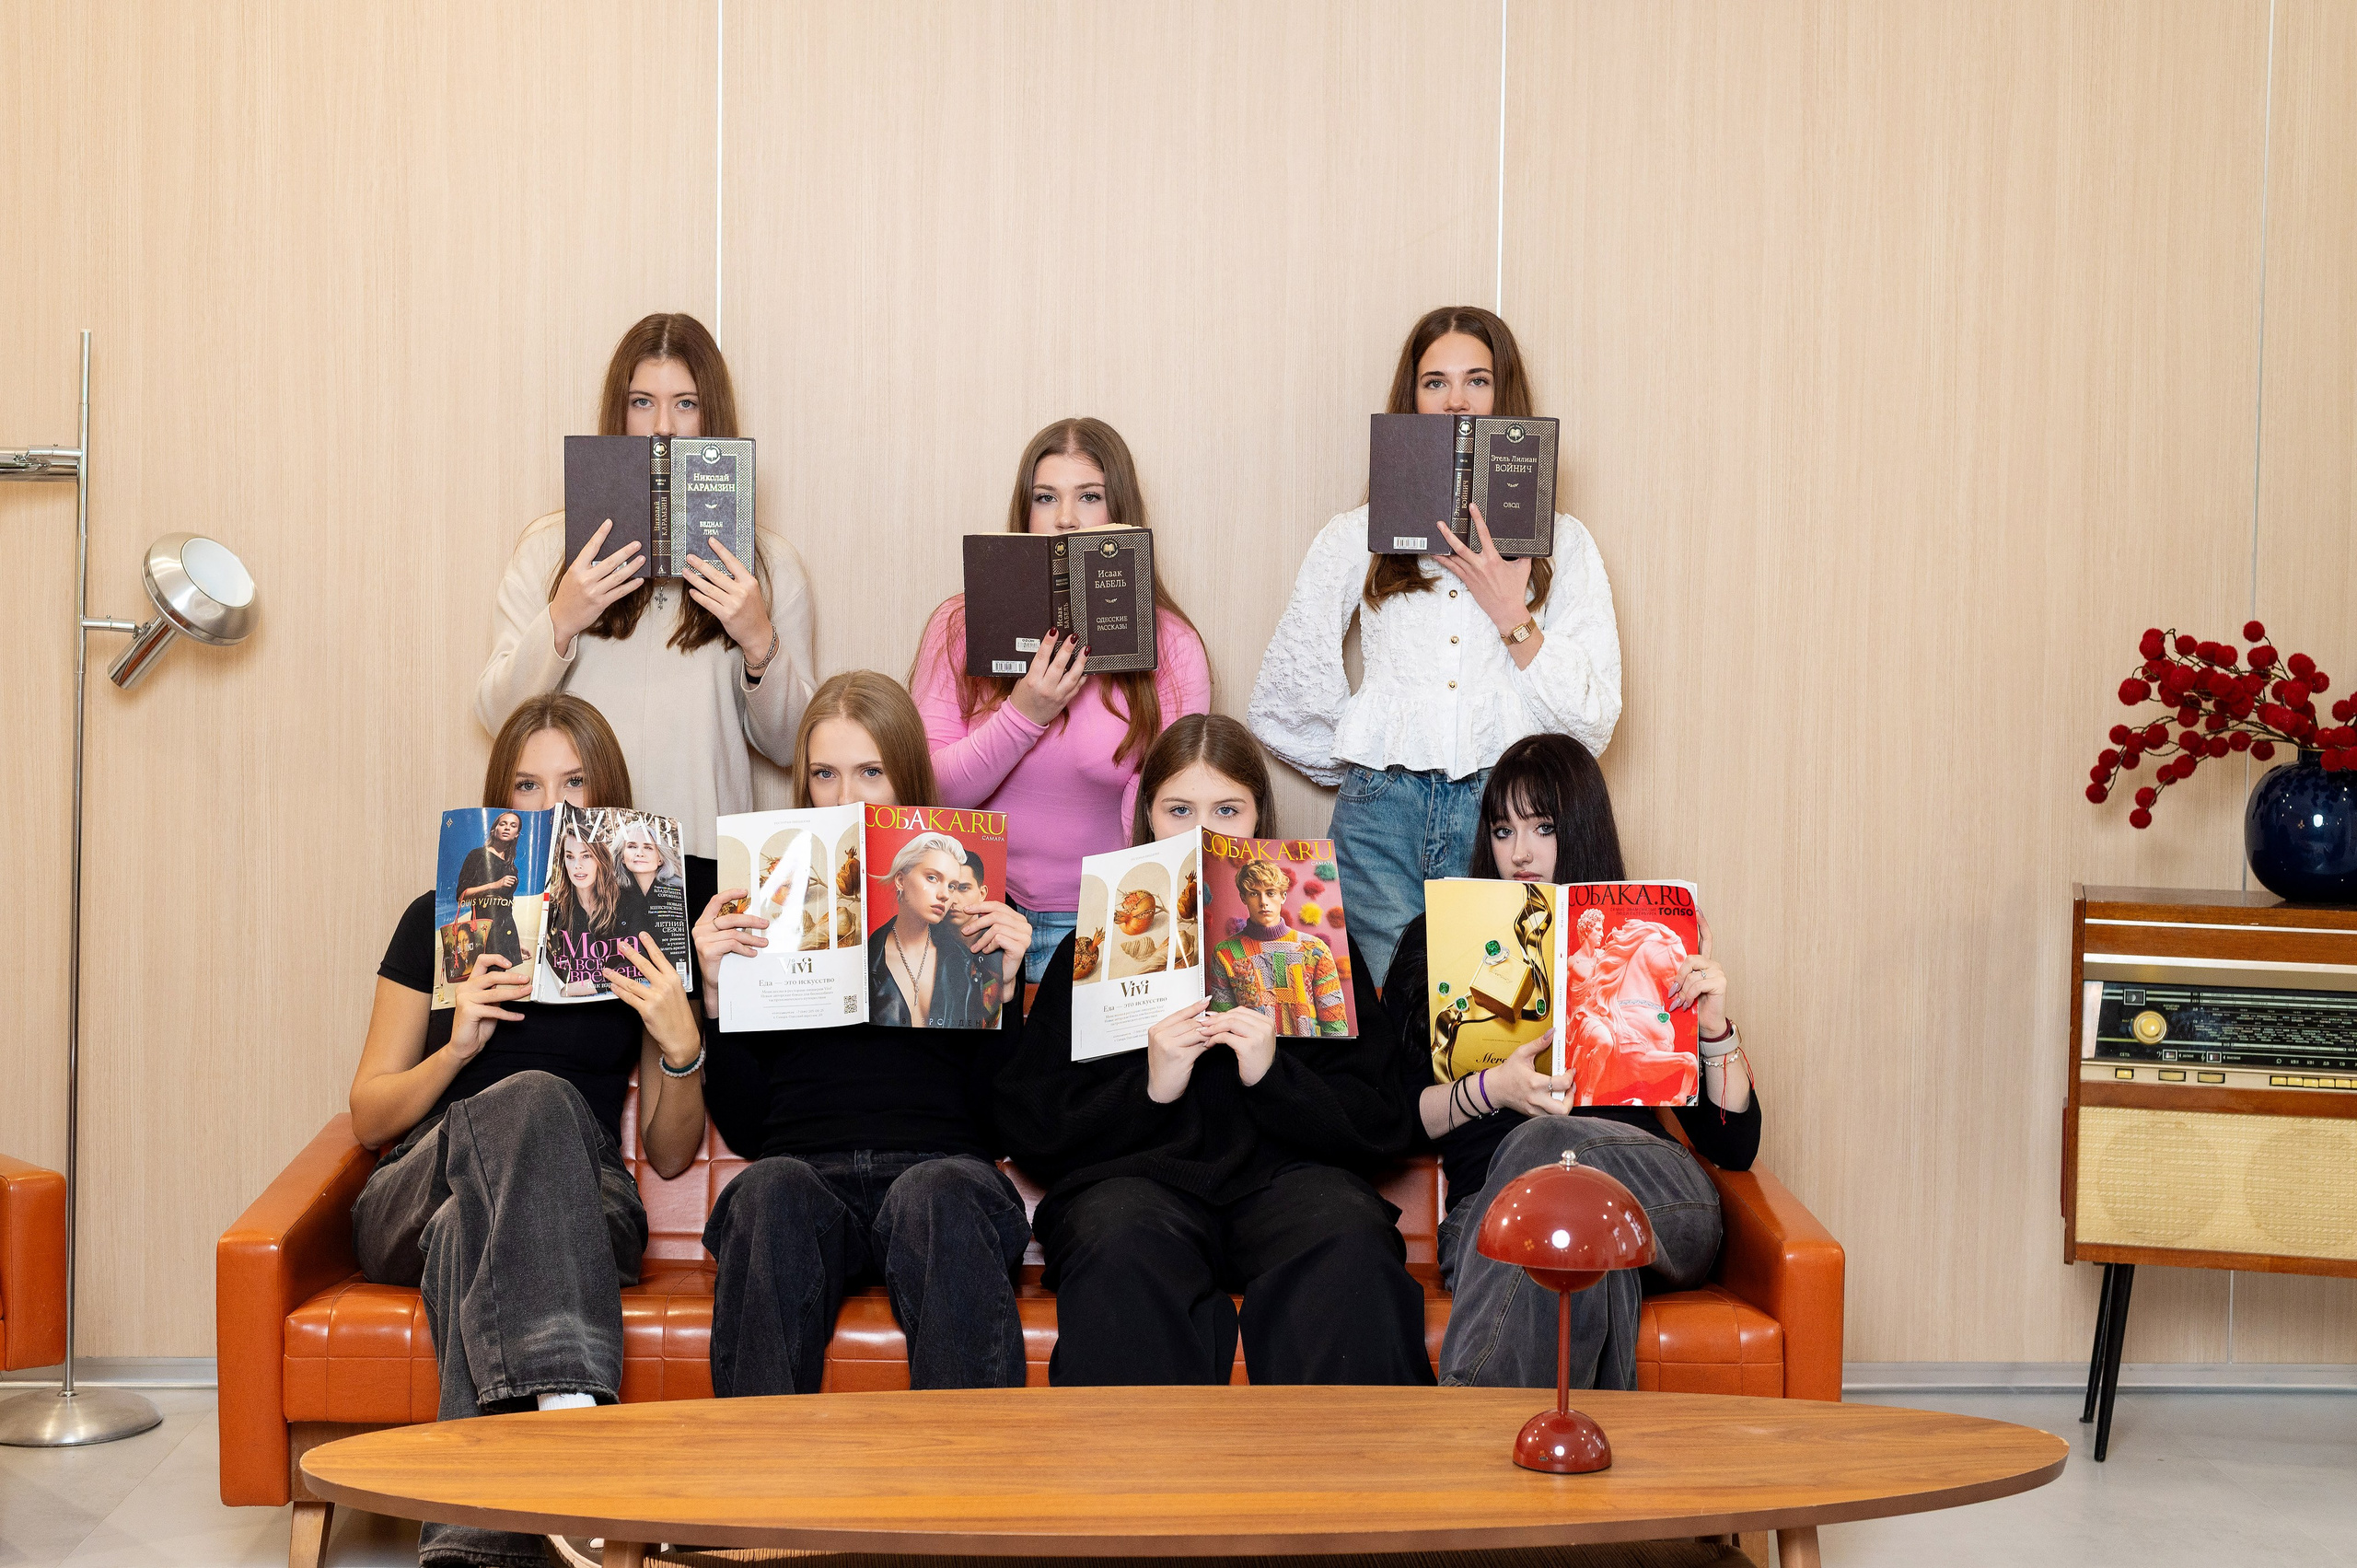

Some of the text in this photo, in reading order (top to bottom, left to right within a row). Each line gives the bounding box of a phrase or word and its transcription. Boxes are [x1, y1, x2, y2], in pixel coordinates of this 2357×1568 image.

[1491, 454, 1538, 463] Этель Лилиан
[1495, 463, 1532, 473] ВОЙНИЧ
[693, 472, 729, 482] Николай
[687, 482, 736, 492] КАРАМЗИН
[1097, 570, 1122, 578] Исаак
[1095, 579, 1127, 588] БАБЕЛЬ
[1096, 615, 1128, 623] ОДЕССКИЕ
[865, 805, 1008, 835] СОБАКА.RU
[1202, 830, 1332, 861] СОБАКА.RU
[458, 897, 515, 909] LOUIS VUITTON
[575, 958, 604, 971] ВСЕ
[759, 979, 773, 987] Еда
[798, 977, 835, 986] искусство
[1120, 980, 1149, 997] Vivi
[1103, 1005, 1115, 1013] Еда
[1135, 996, 1167, 1006] искусство
